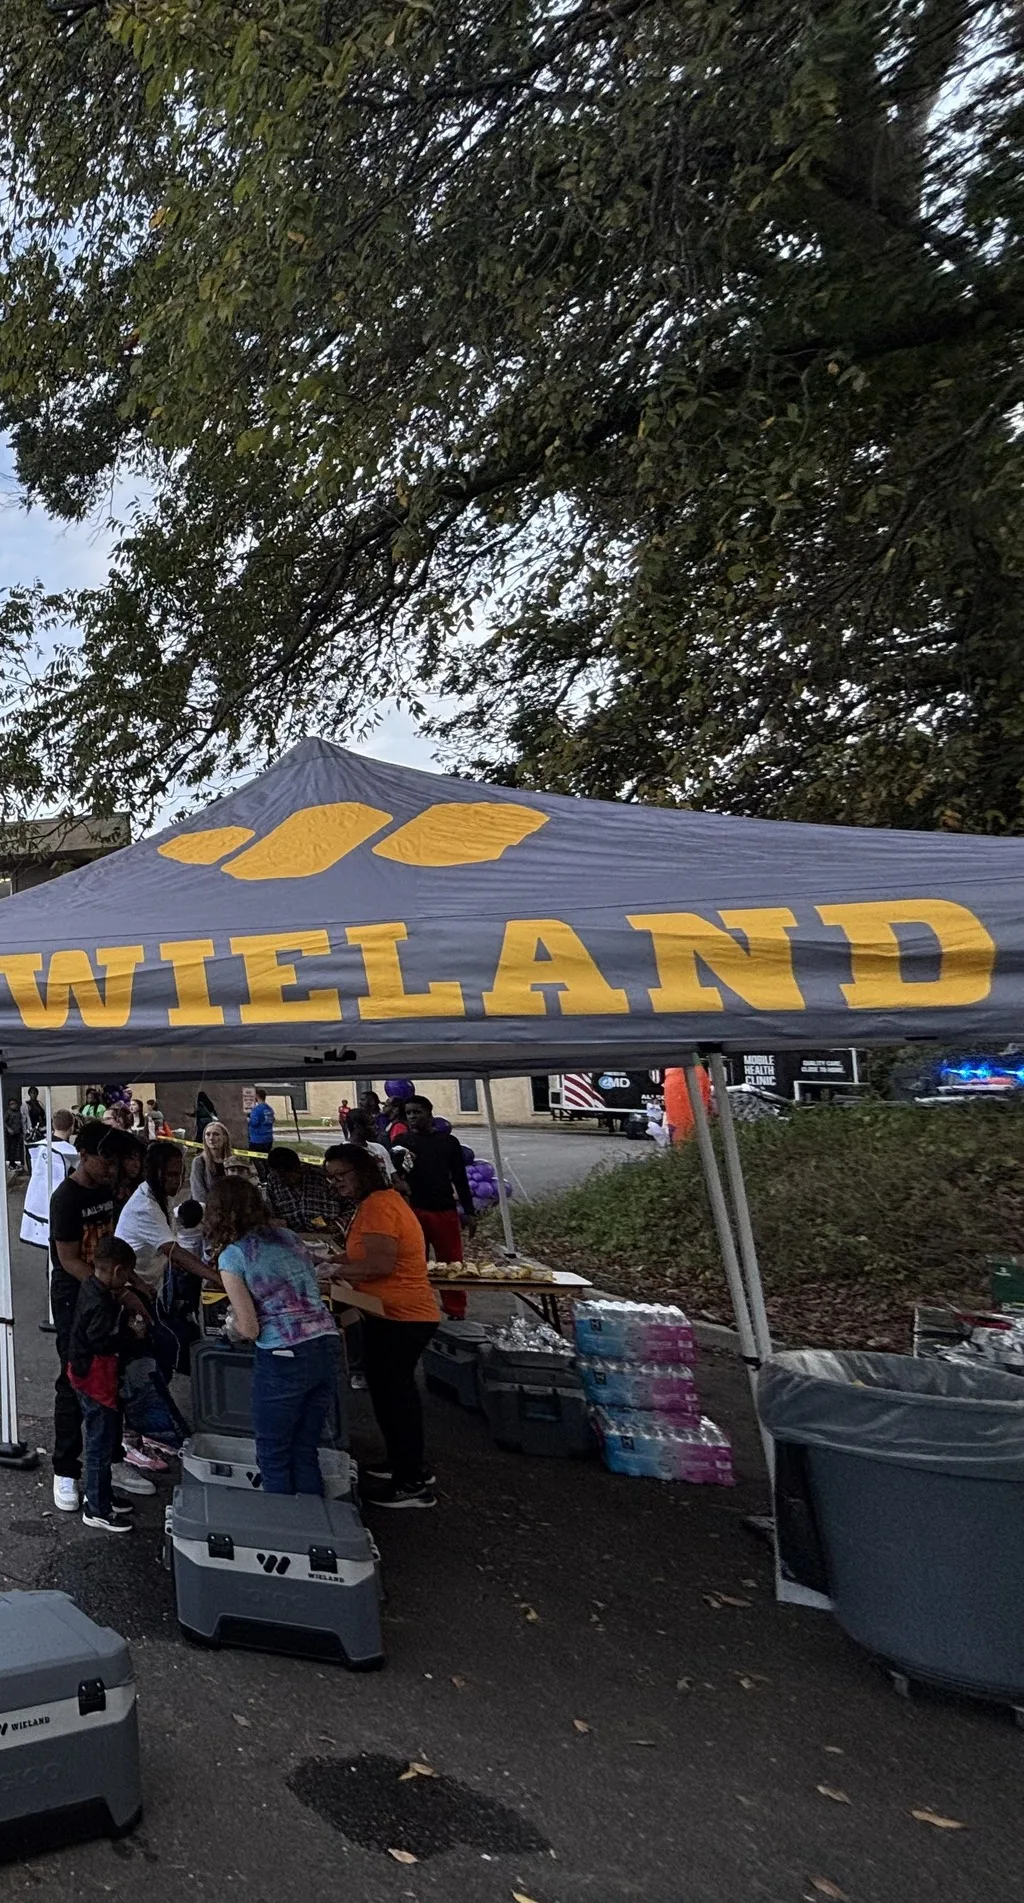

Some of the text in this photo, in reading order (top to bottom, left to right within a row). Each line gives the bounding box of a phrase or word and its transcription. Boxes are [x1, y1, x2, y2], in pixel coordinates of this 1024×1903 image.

[743, 1055, 775, 1065] MOBILE
[744, 1065, 775, 1075] HEALTH
[745, 1075, 776, 1086] CLINIC
[308, 1572, 345, 1583] WIELAND
[11, 1716, 50, 1731] WIELAND
